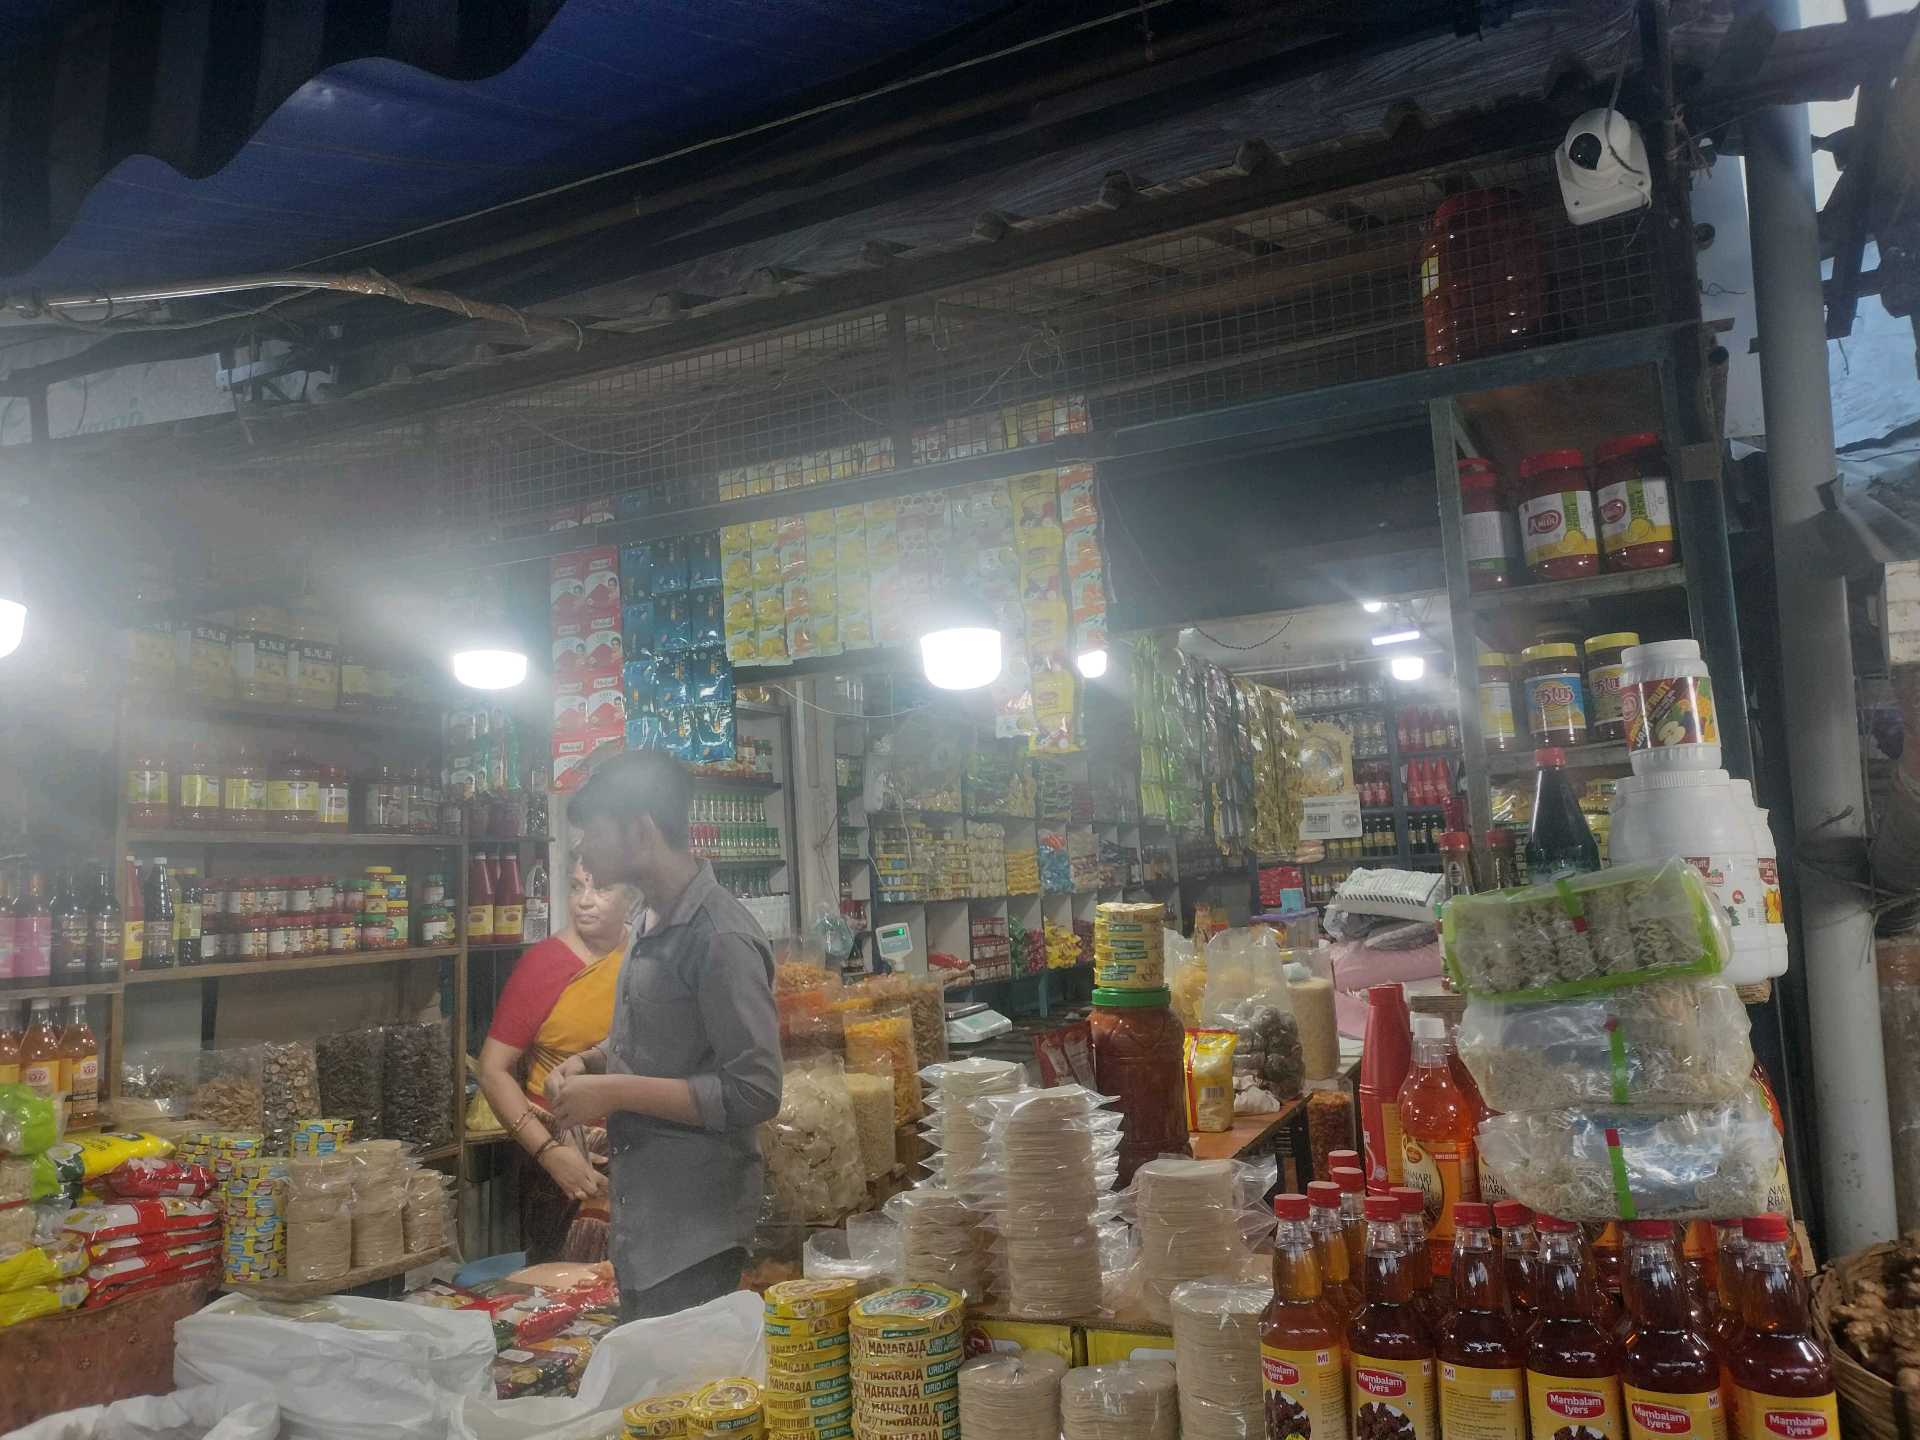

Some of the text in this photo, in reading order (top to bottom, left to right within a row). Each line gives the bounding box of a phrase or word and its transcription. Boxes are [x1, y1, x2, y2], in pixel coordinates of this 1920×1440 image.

[866, 1368, 924, 1381] MAHARAJA
[1359, 1372, 1402, 1387] Mambalam
[864, 1384, 920, 1399] MAHARAJA
[1369, 1379, 1390, 1393] Iyers
[1550, 1394, 1601, 1406] Mambalam
[1565, 1404, 1589, 1415] Iyers
[1634, 1406, 1686, 1423] Mambalam
[1647, 1418, 1671, 1430] Iyers
[1769, 1416, 1825, 1428] Mambalam
[1786, 1426, 1813, 1437] Iyers
